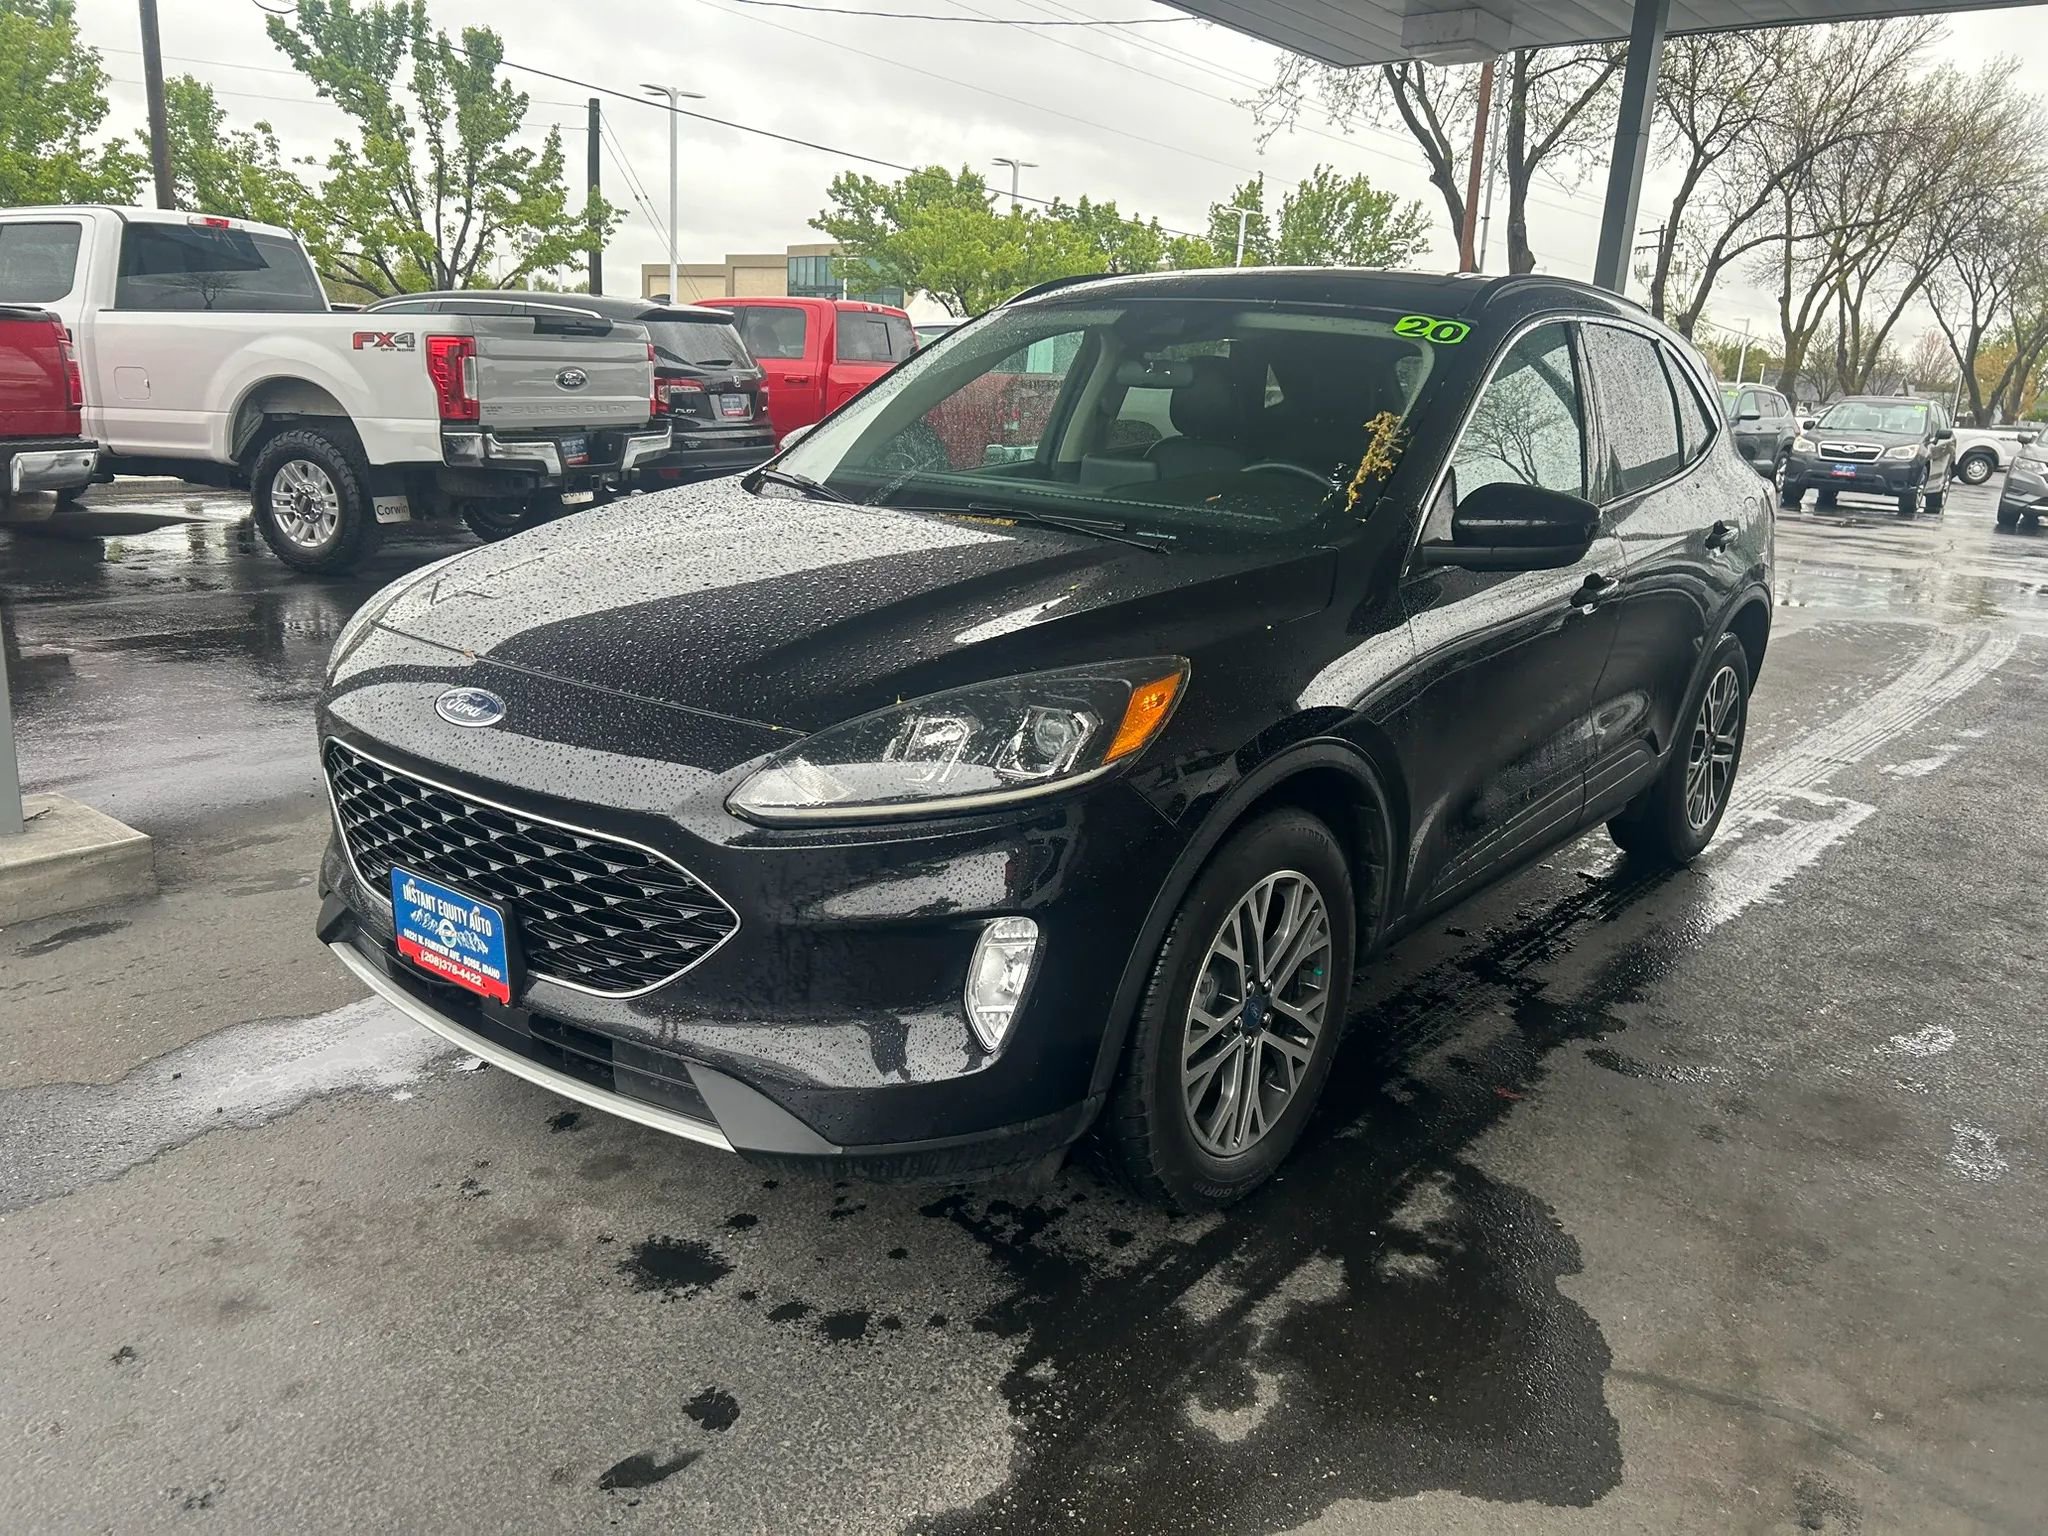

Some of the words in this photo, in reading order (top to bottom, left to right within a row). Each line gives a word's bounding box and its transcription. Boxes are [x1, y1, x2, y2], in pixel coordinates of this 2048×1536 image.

[353, 331, 416, 350] FX4
[1397, 318, 1466, 342] 20
[510, 405, 579, 415] SUPER
[584, 404, 630, 414] DUTY
[376, 503, 408, 516] Corwin
[446, 692, 488, 718] Ford
[402, 883, 436, 913] INSTANT
[437, 899, 467, 926] EQUITY
[469, 911, 493, 937] AUTO
[420, 949, 483, 987] (208)378-4422
[481, 963, 501, 980] IDAHO
